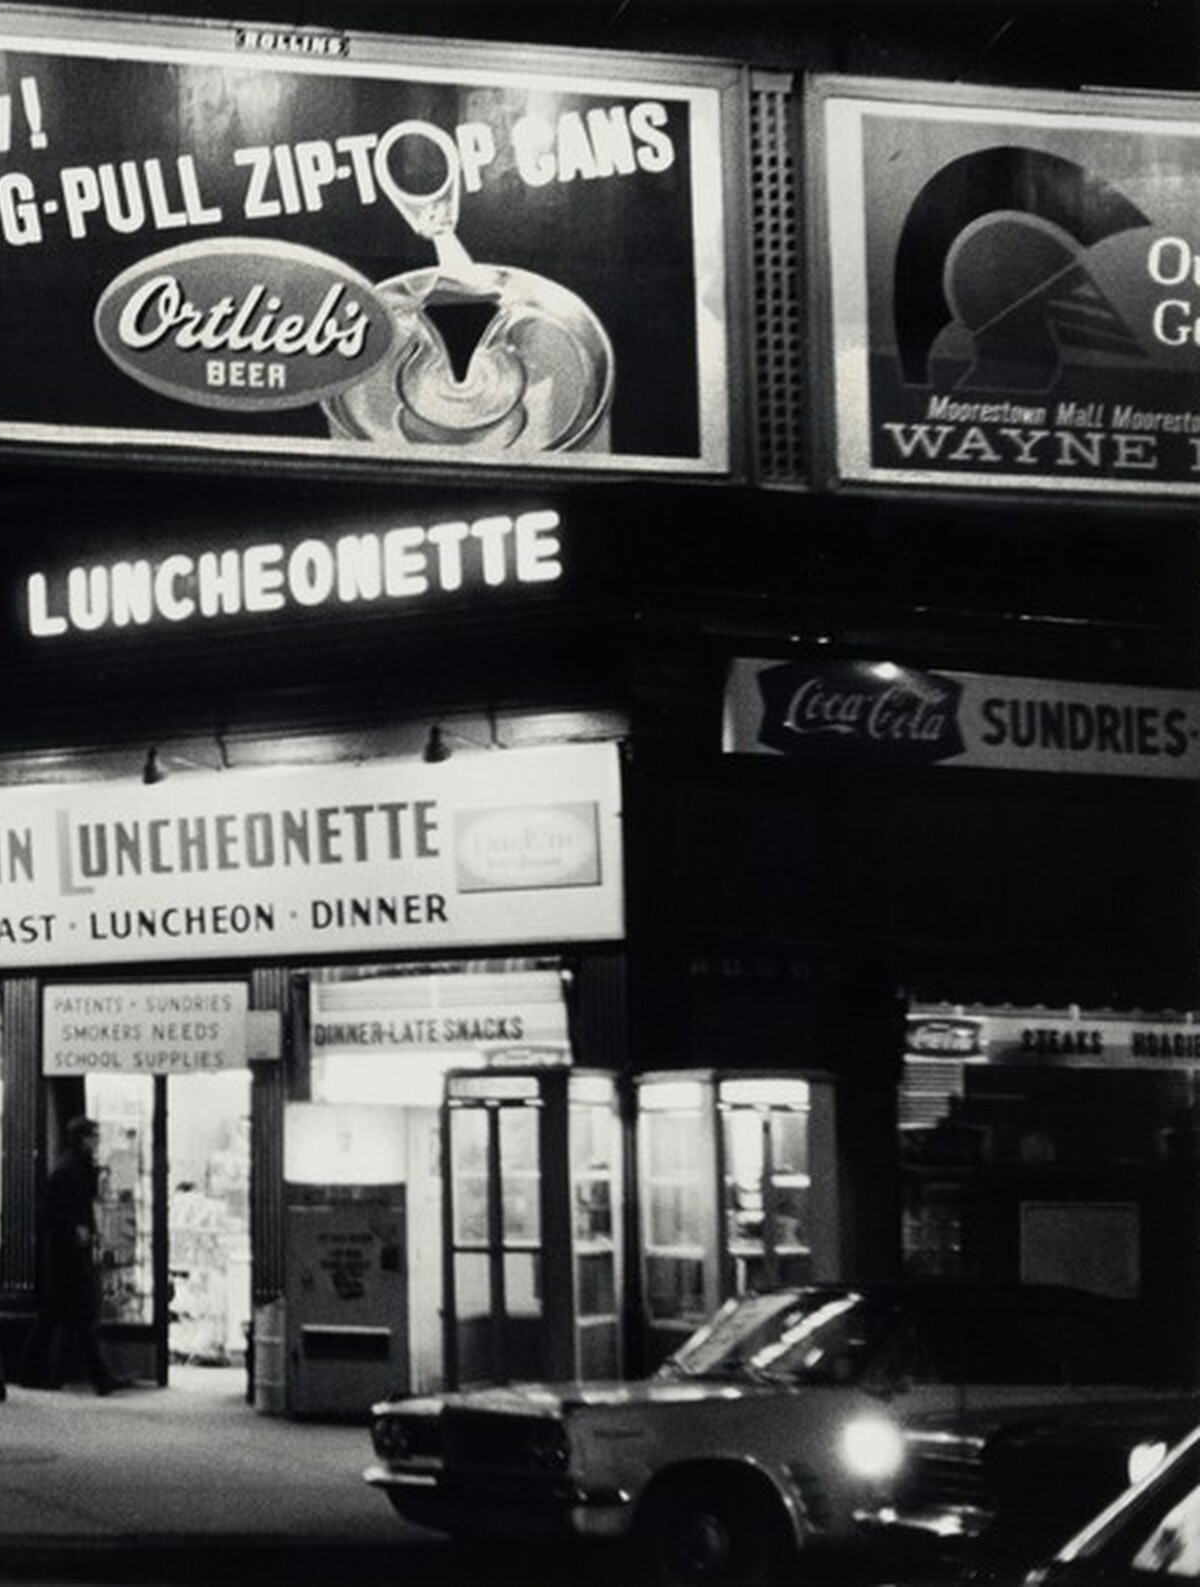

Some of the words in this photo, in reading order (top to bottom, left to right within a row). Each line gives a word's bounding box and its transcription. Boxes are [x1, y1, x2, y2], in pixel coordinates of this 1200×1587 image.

[512, 102, 675, 187] CANS
[118, 275, 370, 356] Ortlieb's
[206, 360, 286, 389] BEER
[926, 395, 1047, 425] Moorestown
[1055, 402, 1104, 428] Mall
[882, 423, 1158, 470] WAYNE
[28, 510, 562, 636] LUNCHEONETTE
[56, 799, 440, 896] LUNCHEONETTE
[90, 902, 275, 940] LUNCHEON
[311, 893, 449, 930] DINNER
[54, 996, 123, 1014] PATENTS
[144, 994, 233, 1013] SUNDRIES
[62, 1023, 142, 1041] SMOKERS
[152, 1022, 220, 1041] NEEDS
[443, 1016, 525, 1042] SNACKS
[1021, 1028, 1104, 1055] STEAKS
[54, 1051, 122, 1068] SCHOOL
[133, 1050, 225, 1068] SUPPLIES
